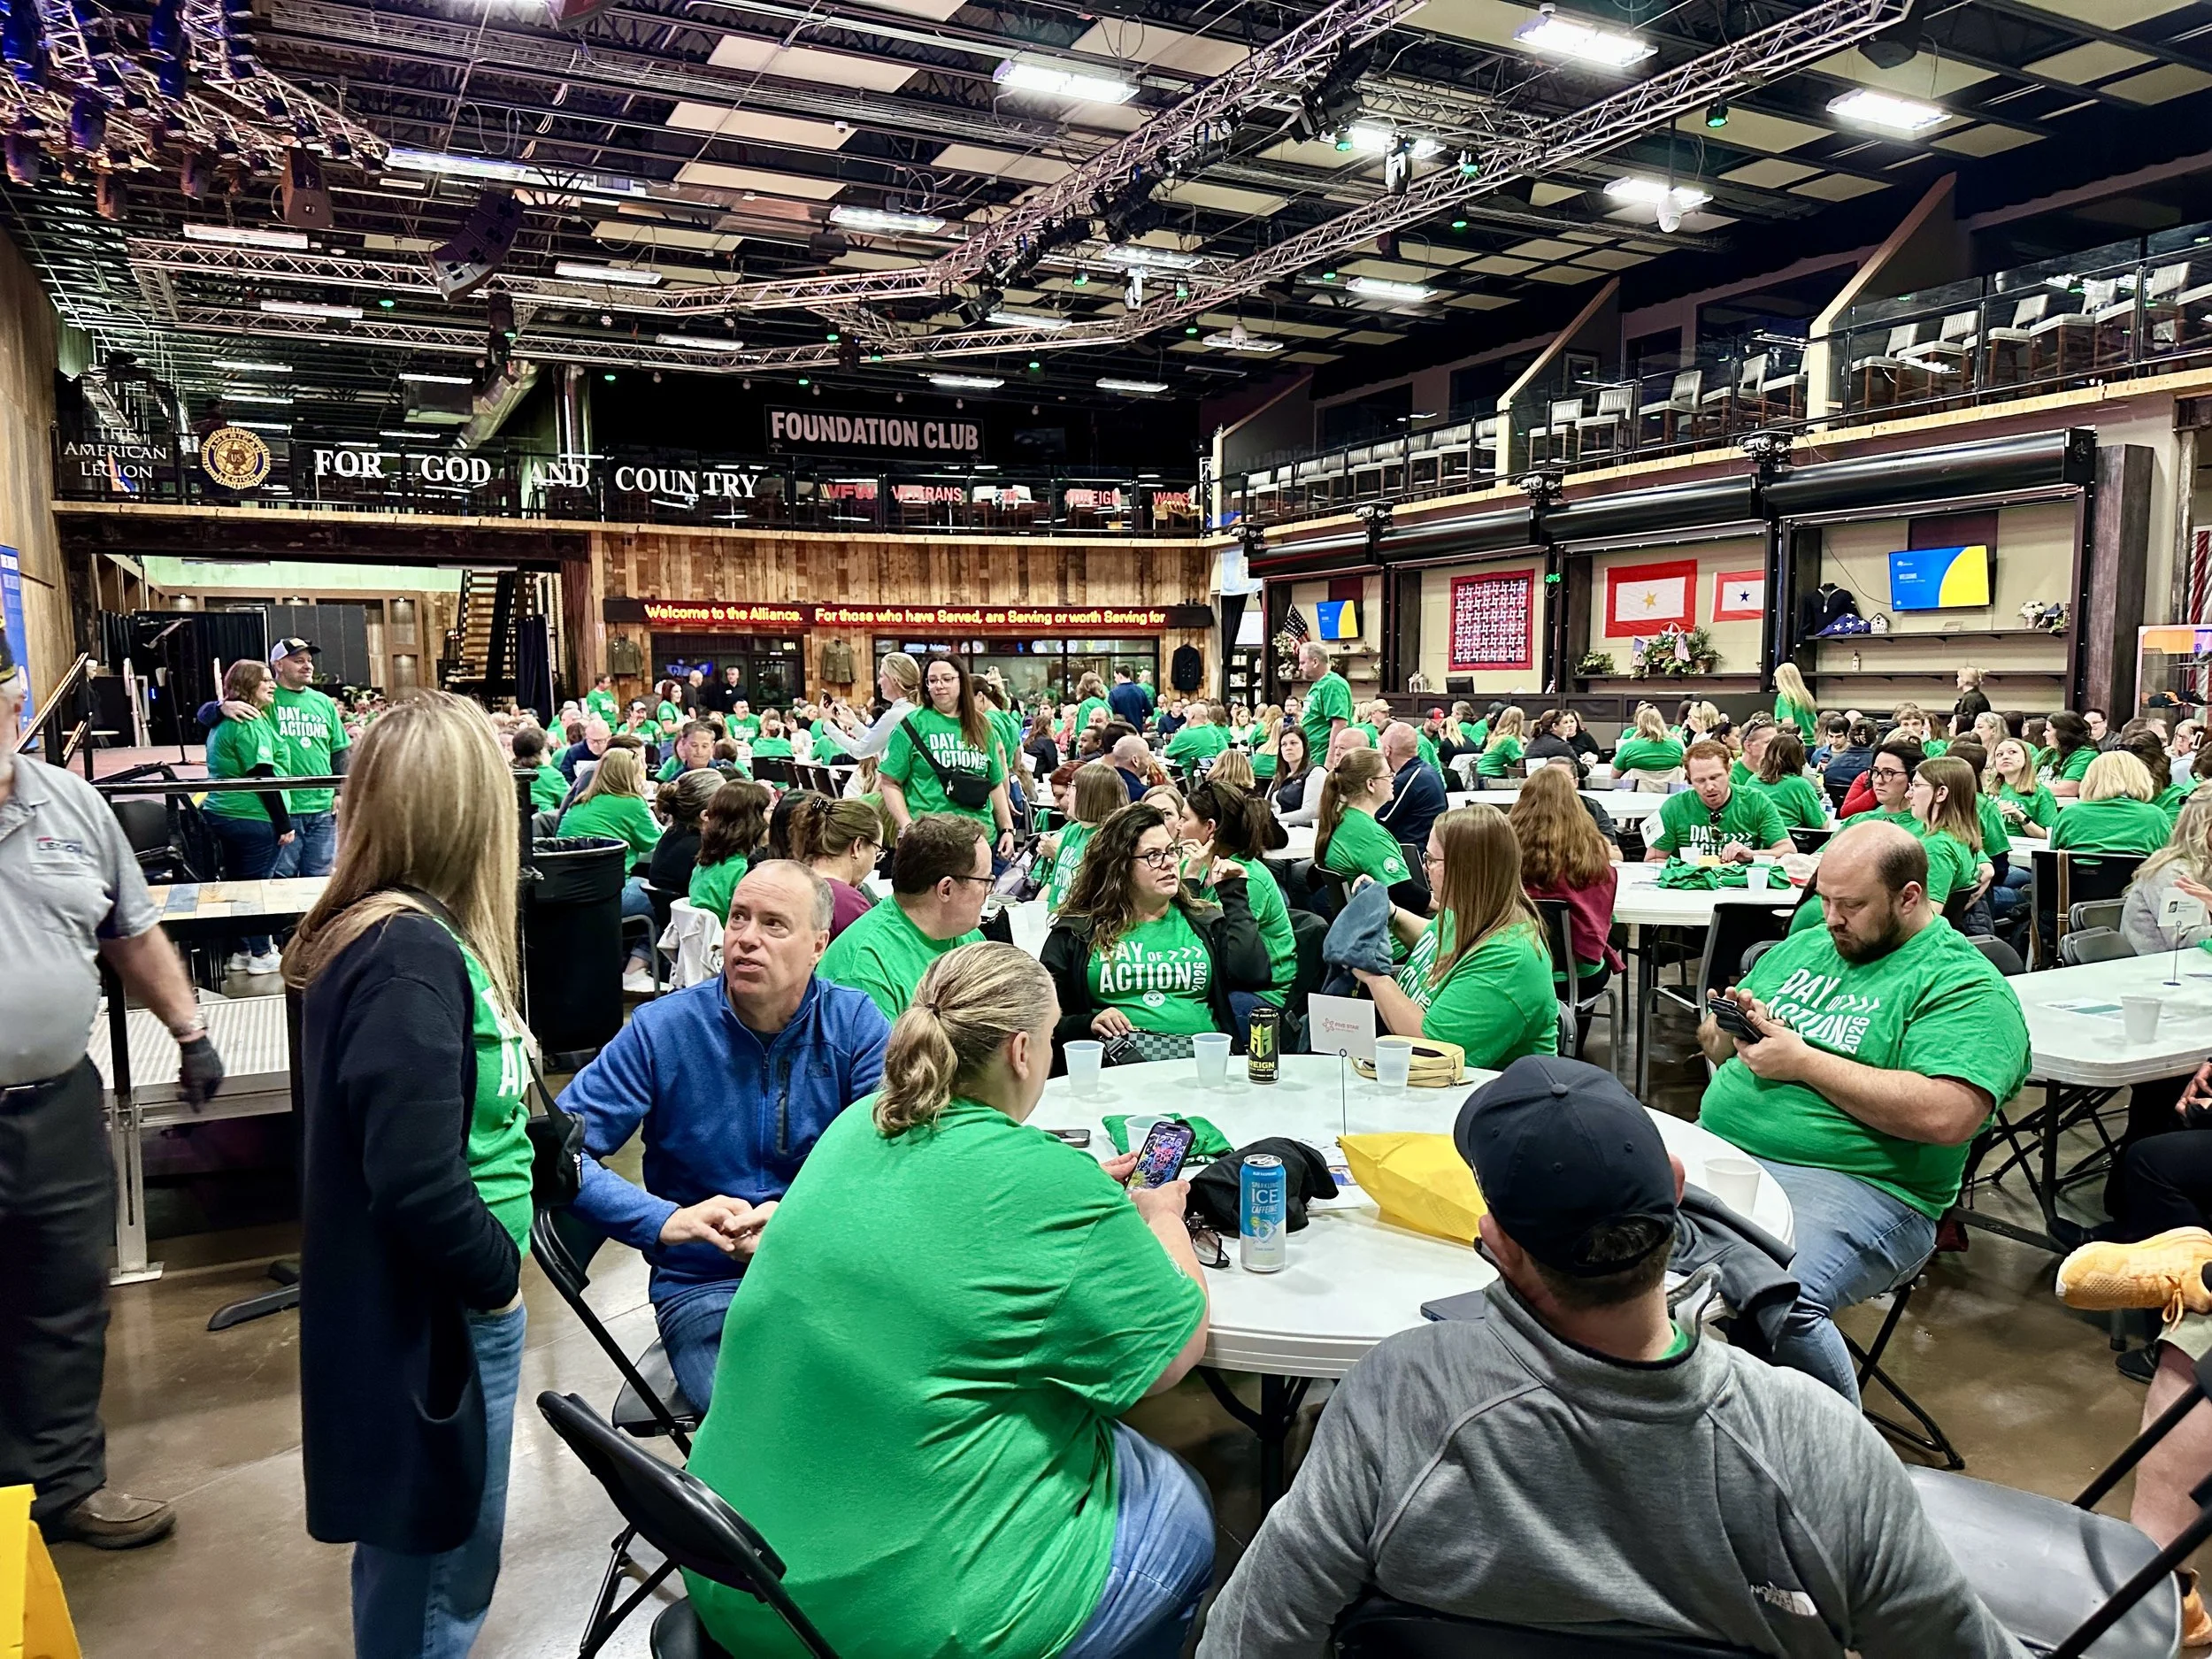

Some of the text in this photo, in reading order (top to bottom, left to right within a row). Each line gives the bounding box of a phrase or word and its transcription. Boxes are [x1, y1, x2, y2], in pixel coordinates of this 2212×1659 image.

[95, 425, 134, 441] THE
[772, 411, 979, 451] FOUNDATION CLUB
[64, 442, 167, 460] AMERICAN
[230, 453, 243, 463] US
[80, 461, 153, 479] LEGION
[312, 449, 386, 479] FOR
[420, 455, 492, 484] GOD
[530, 461, 590, 488] AND
[827, 484, 876, 500] VFW
[644, 603, 803, 622] Welcome to the Alliance.
[815, 607, 1166, 626] For those who have Served, are Serving or worth Serving for
[277, 705, 301, 721] DAY
[279, 721, 321, 737] ACTION
[929, 733, 955, 750] DAY
[933, 749, 979, 770] ACTION
[1147, 951, 1163, 962] OF
[1099, 961, 1191, 994] ACTION
[1191, 961, 1208, 992] 2026
[1776, 968, 1842, 1010] DAY
[1765, 995, 1854, 1045] ACTION
[1838, 1016, 1871, 1055] 2026
[1249, 1060, 1275, 1069] REIGN
[1251, 1188, 1280, 1204] ICE
[1251, 1204, 1279, 1214] CAFFEINE
